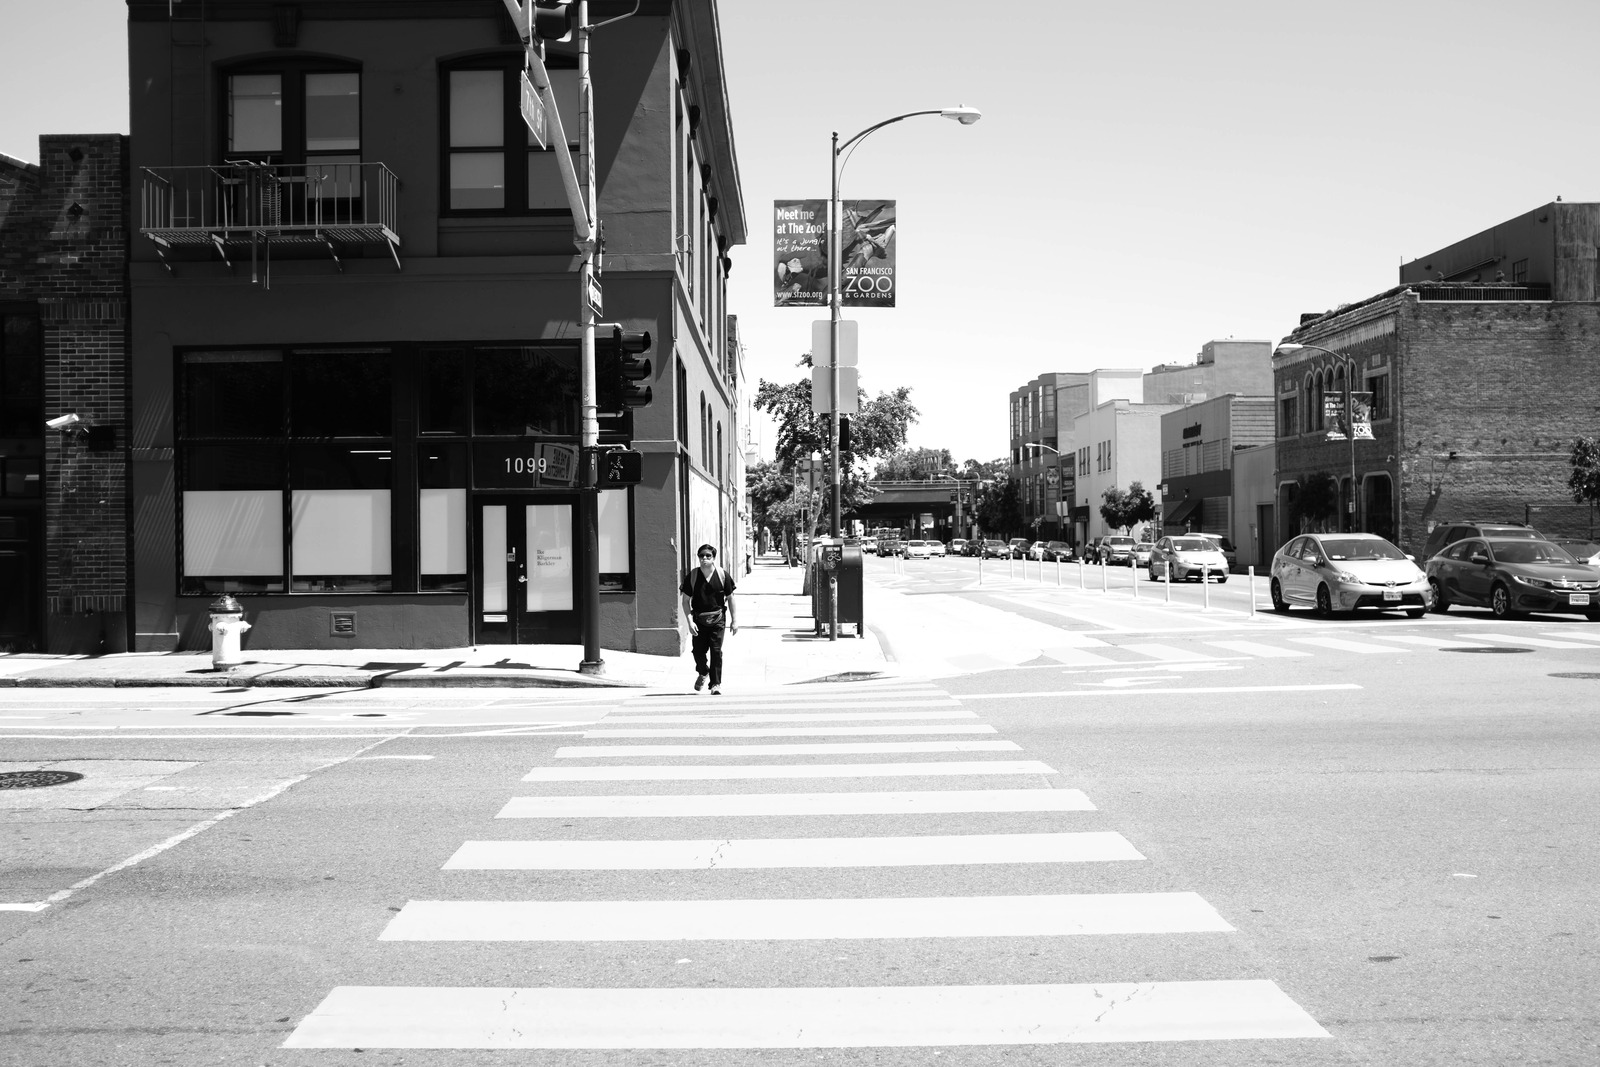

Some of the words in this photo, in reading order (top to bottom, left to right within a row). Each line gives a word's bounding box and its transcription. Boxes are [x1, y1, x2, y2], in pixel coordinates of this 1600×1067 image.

[777, 209, 799, 220] Meet
[800, 210, 815, 220] me
[776, 224, 786, 234] at
[788, 222, 804, 234] The
[805, 222, 826, 234] Zoo!
[845, 276, 893, 293] ZOO
[776, 289, 823, 300] www.sfzoo.org
[504, 457, 547, 473] 1099
